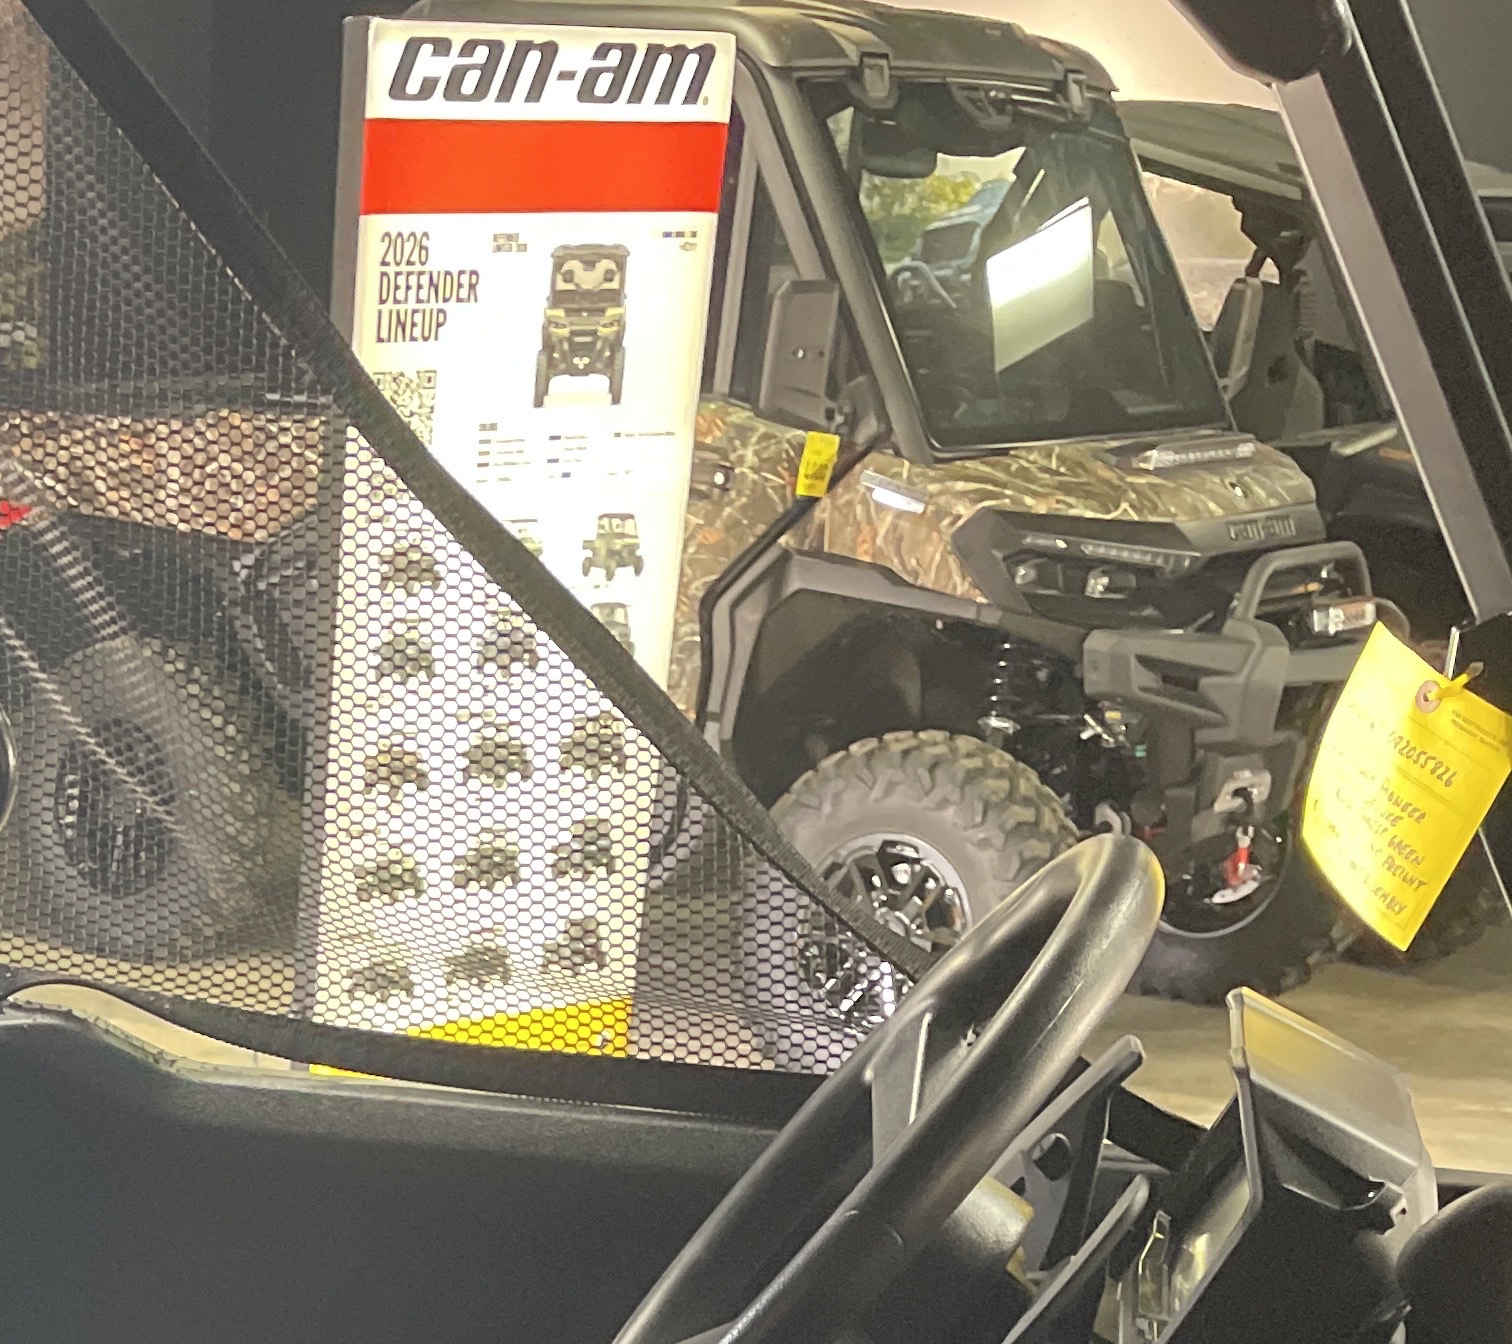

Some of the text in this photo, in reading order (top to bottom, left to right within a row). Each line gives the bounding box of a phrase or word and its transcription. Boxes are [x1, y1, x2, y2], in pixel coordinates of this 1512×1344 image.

[388, 36, 717, 106] can-am
[379, 231, 430, 267] 2026
[378, 269, 480, 305] DEFENDER
[376, 308, 447, 343] LINEUP
